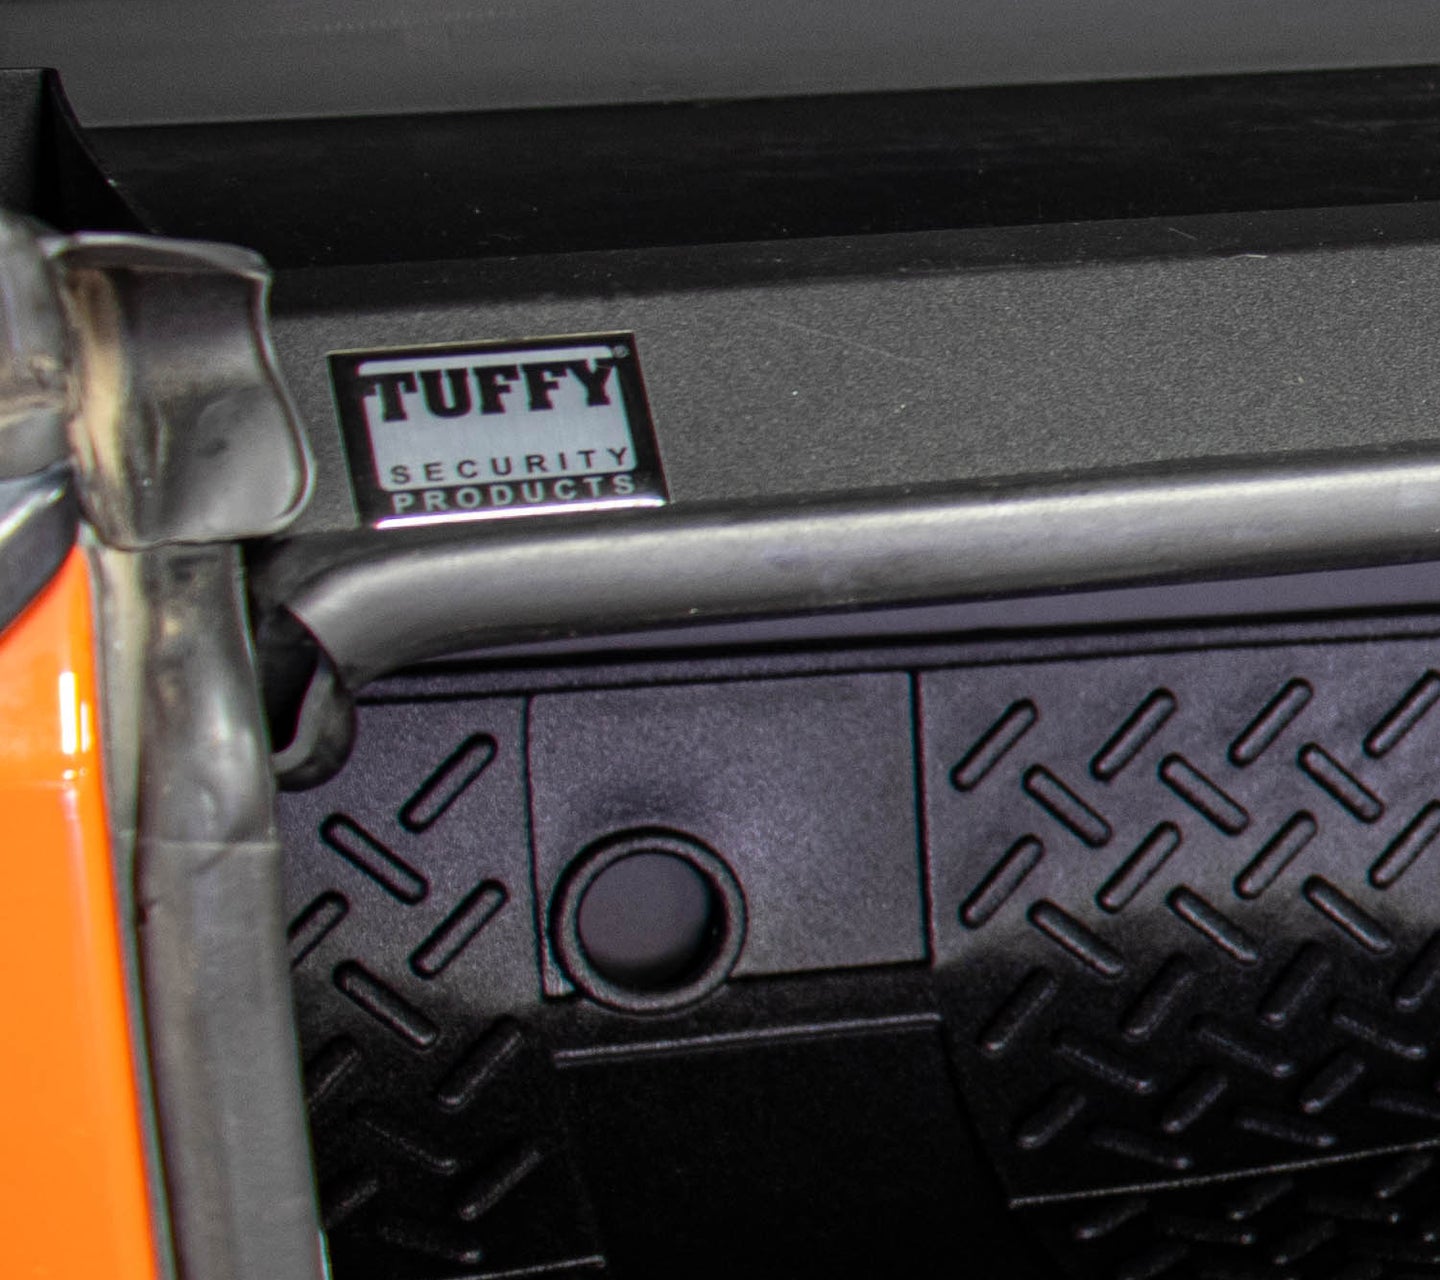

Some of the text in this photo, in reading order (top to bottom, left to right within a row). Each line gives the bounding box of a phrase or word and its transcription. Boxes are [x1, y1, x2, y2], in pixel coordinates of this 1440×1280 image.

[360, 357, 618, 422] TUFFY
[390, 447, 628, 485] SECURITY
[393, 475, 637, 515] PRODUCTS
